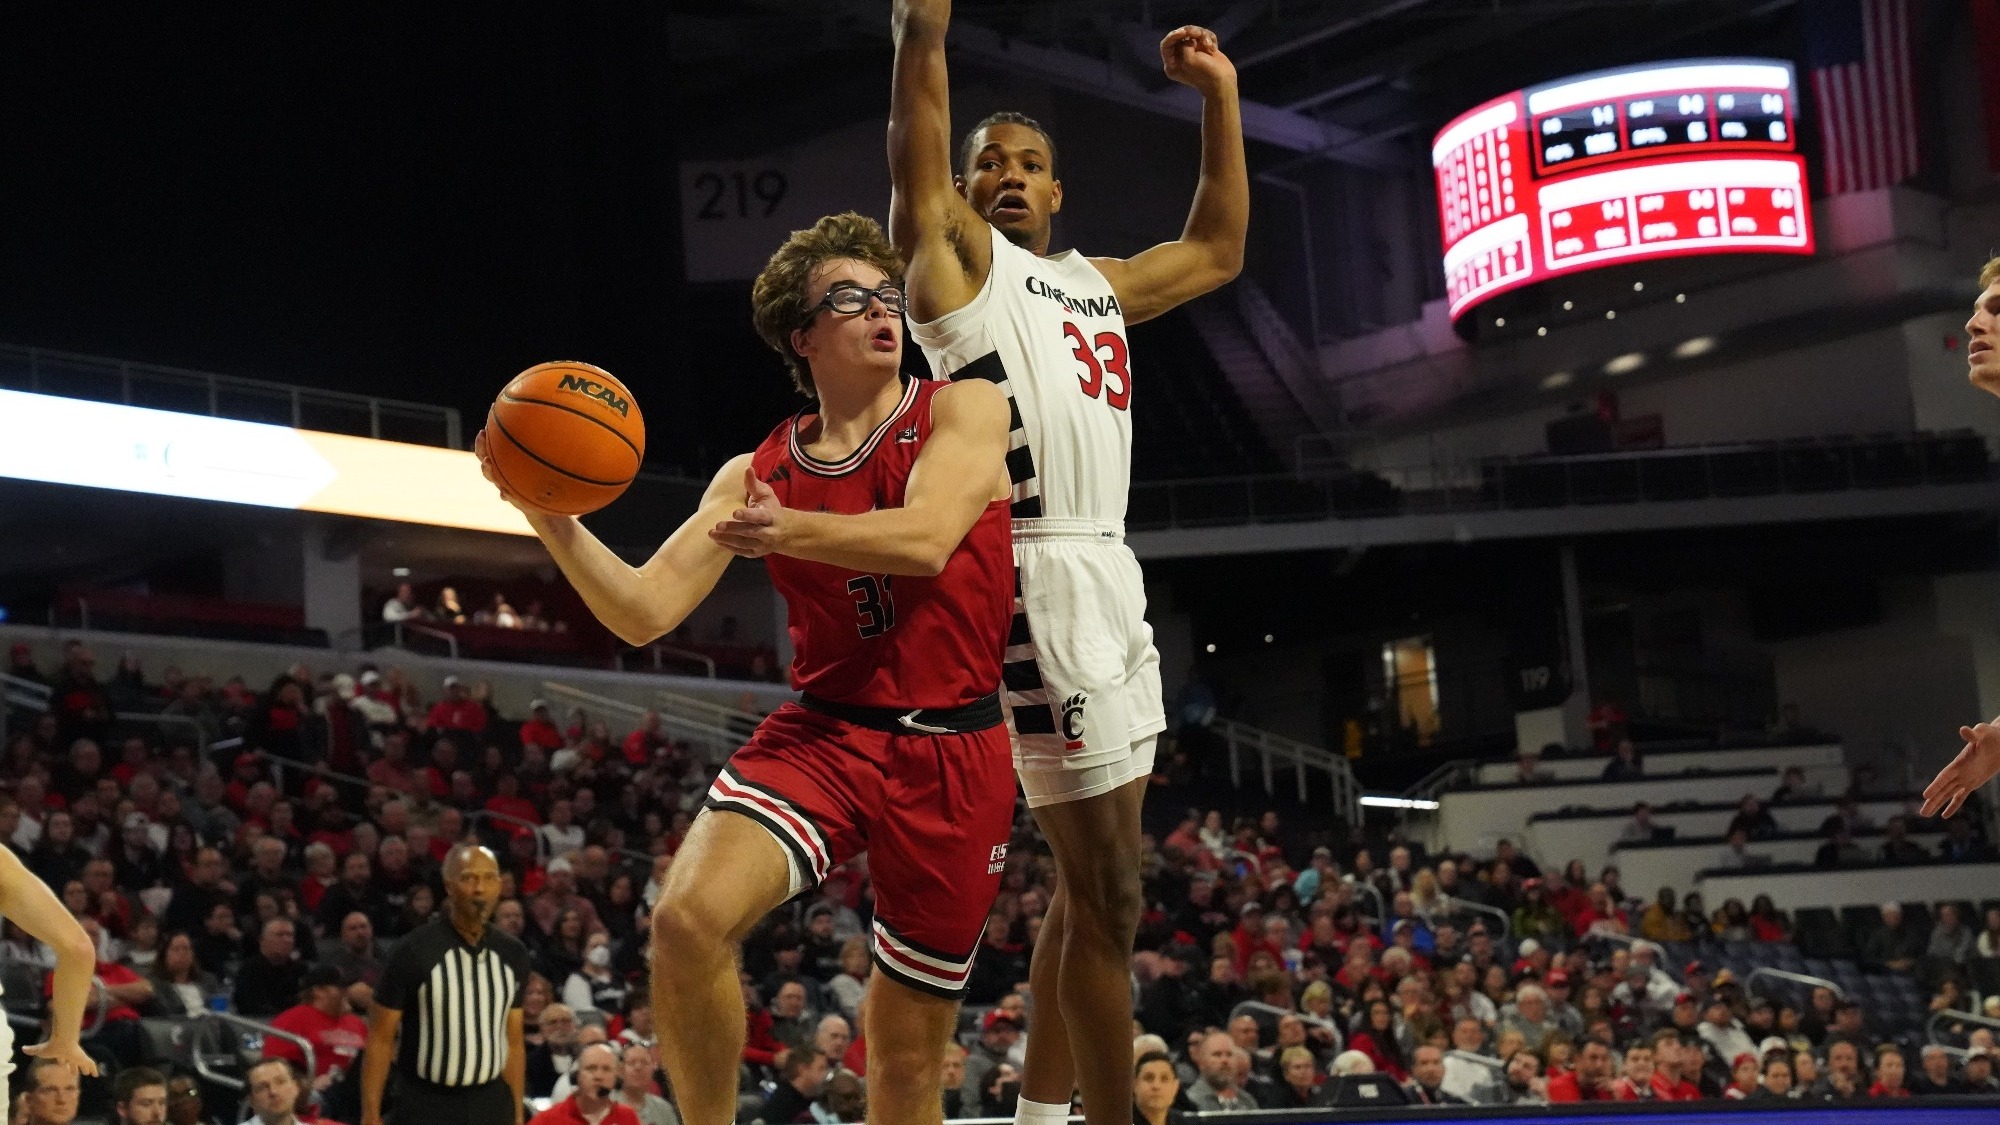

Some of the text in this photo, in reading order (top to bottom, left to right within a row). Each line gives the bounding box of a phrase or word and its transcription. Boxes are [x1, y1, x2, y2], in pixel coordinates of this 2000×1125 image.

[694, 169, 788, 219] 219
[1062, 321, 1131, 411] 33
[557, 373, 630, 419] NCAA
